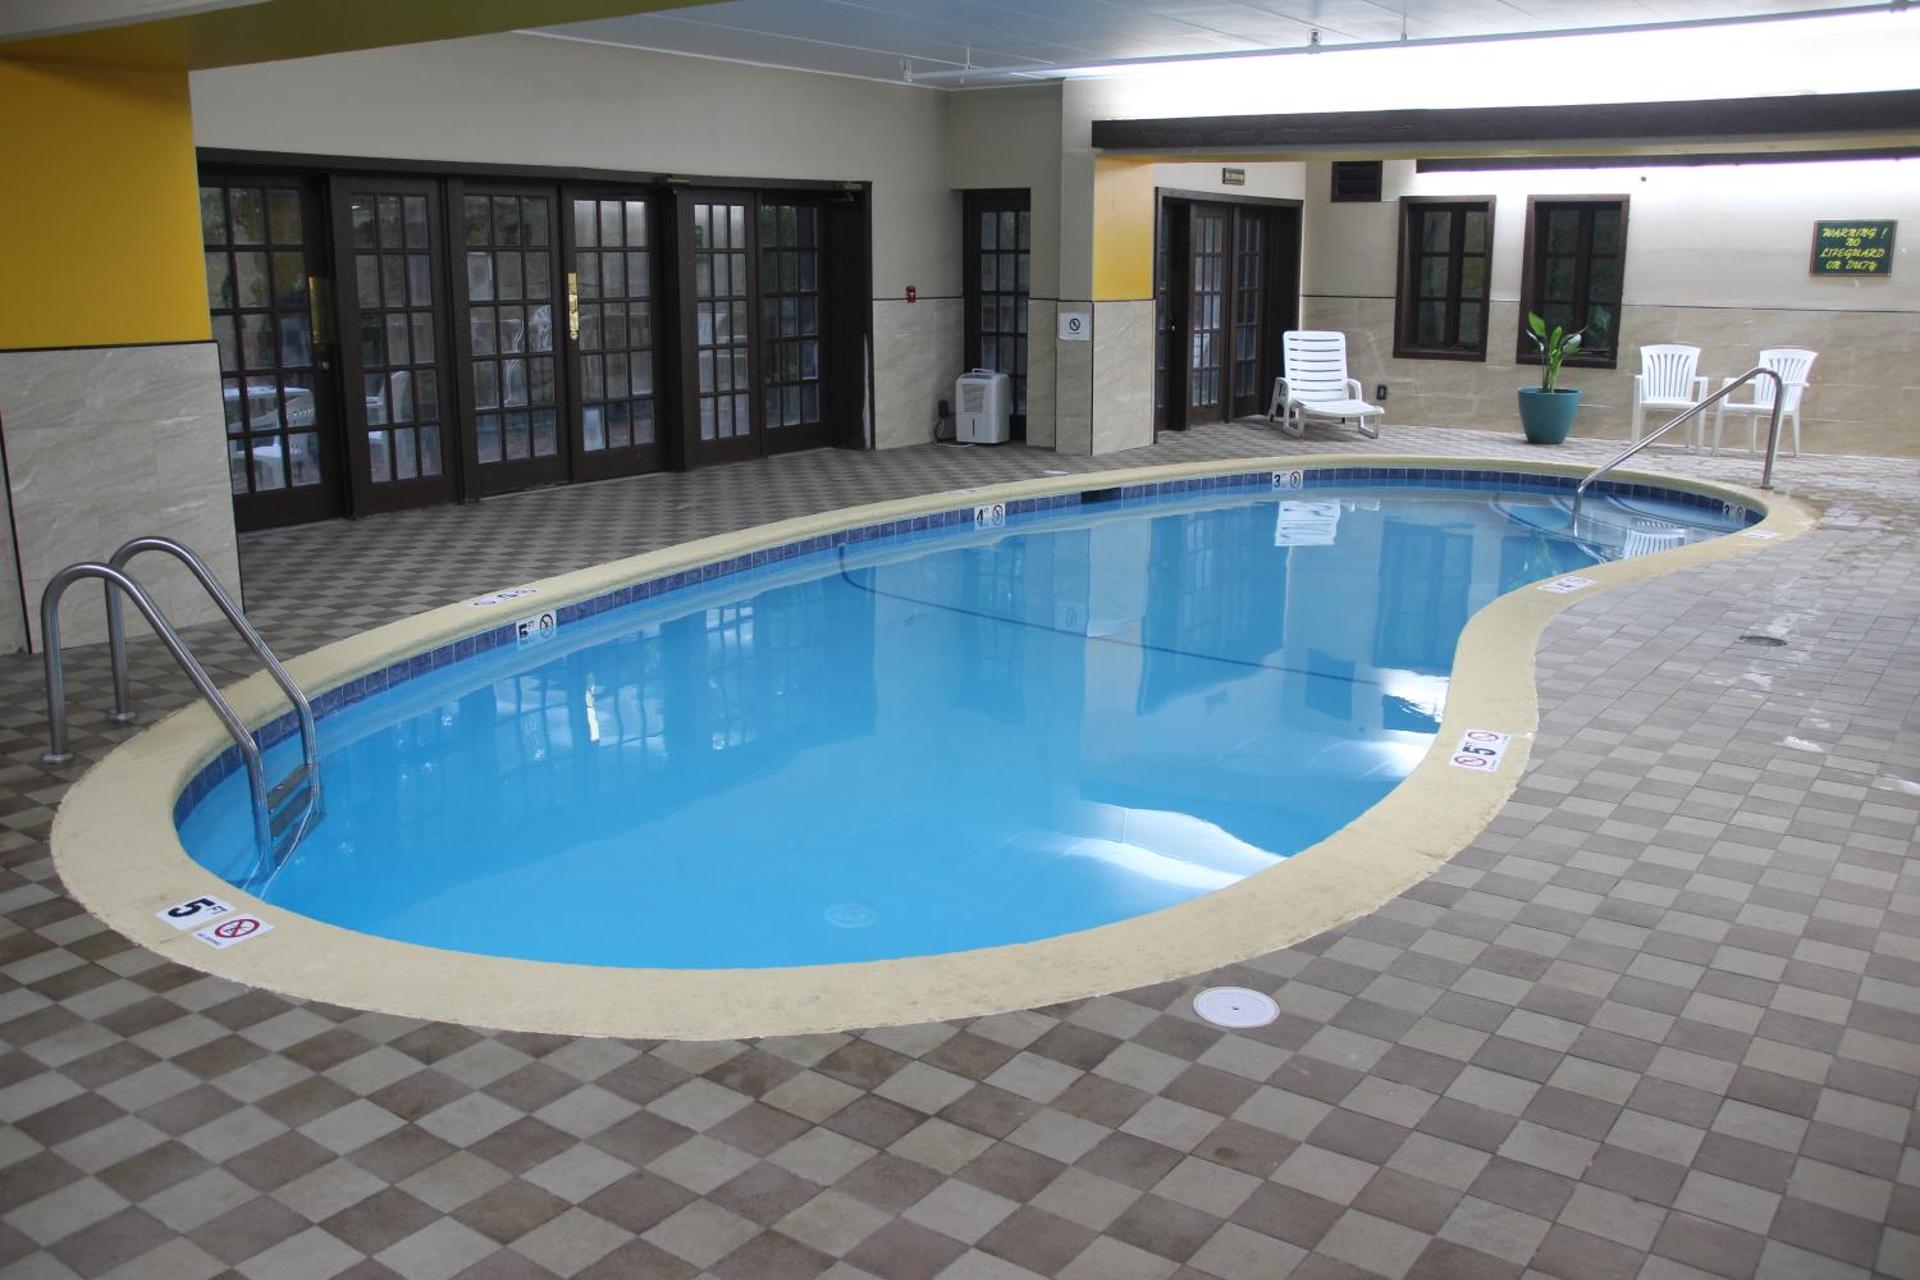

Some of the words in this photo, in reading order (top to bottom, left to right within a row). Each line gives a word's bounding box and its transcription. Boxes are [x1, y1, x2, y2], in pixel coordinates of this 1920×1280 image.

[1822, 227, 1878, 239] WARNING
[1845, 237, 1861, 247] NO
[1820, 247, 1885, 259] LIFEGUARD
[1826, 260, 1841, 270] ON
[1845, 260, 1878, 272] DUTY
[1462, 745, 1496, 756] 5
[168, 898, 216, 918] 5
